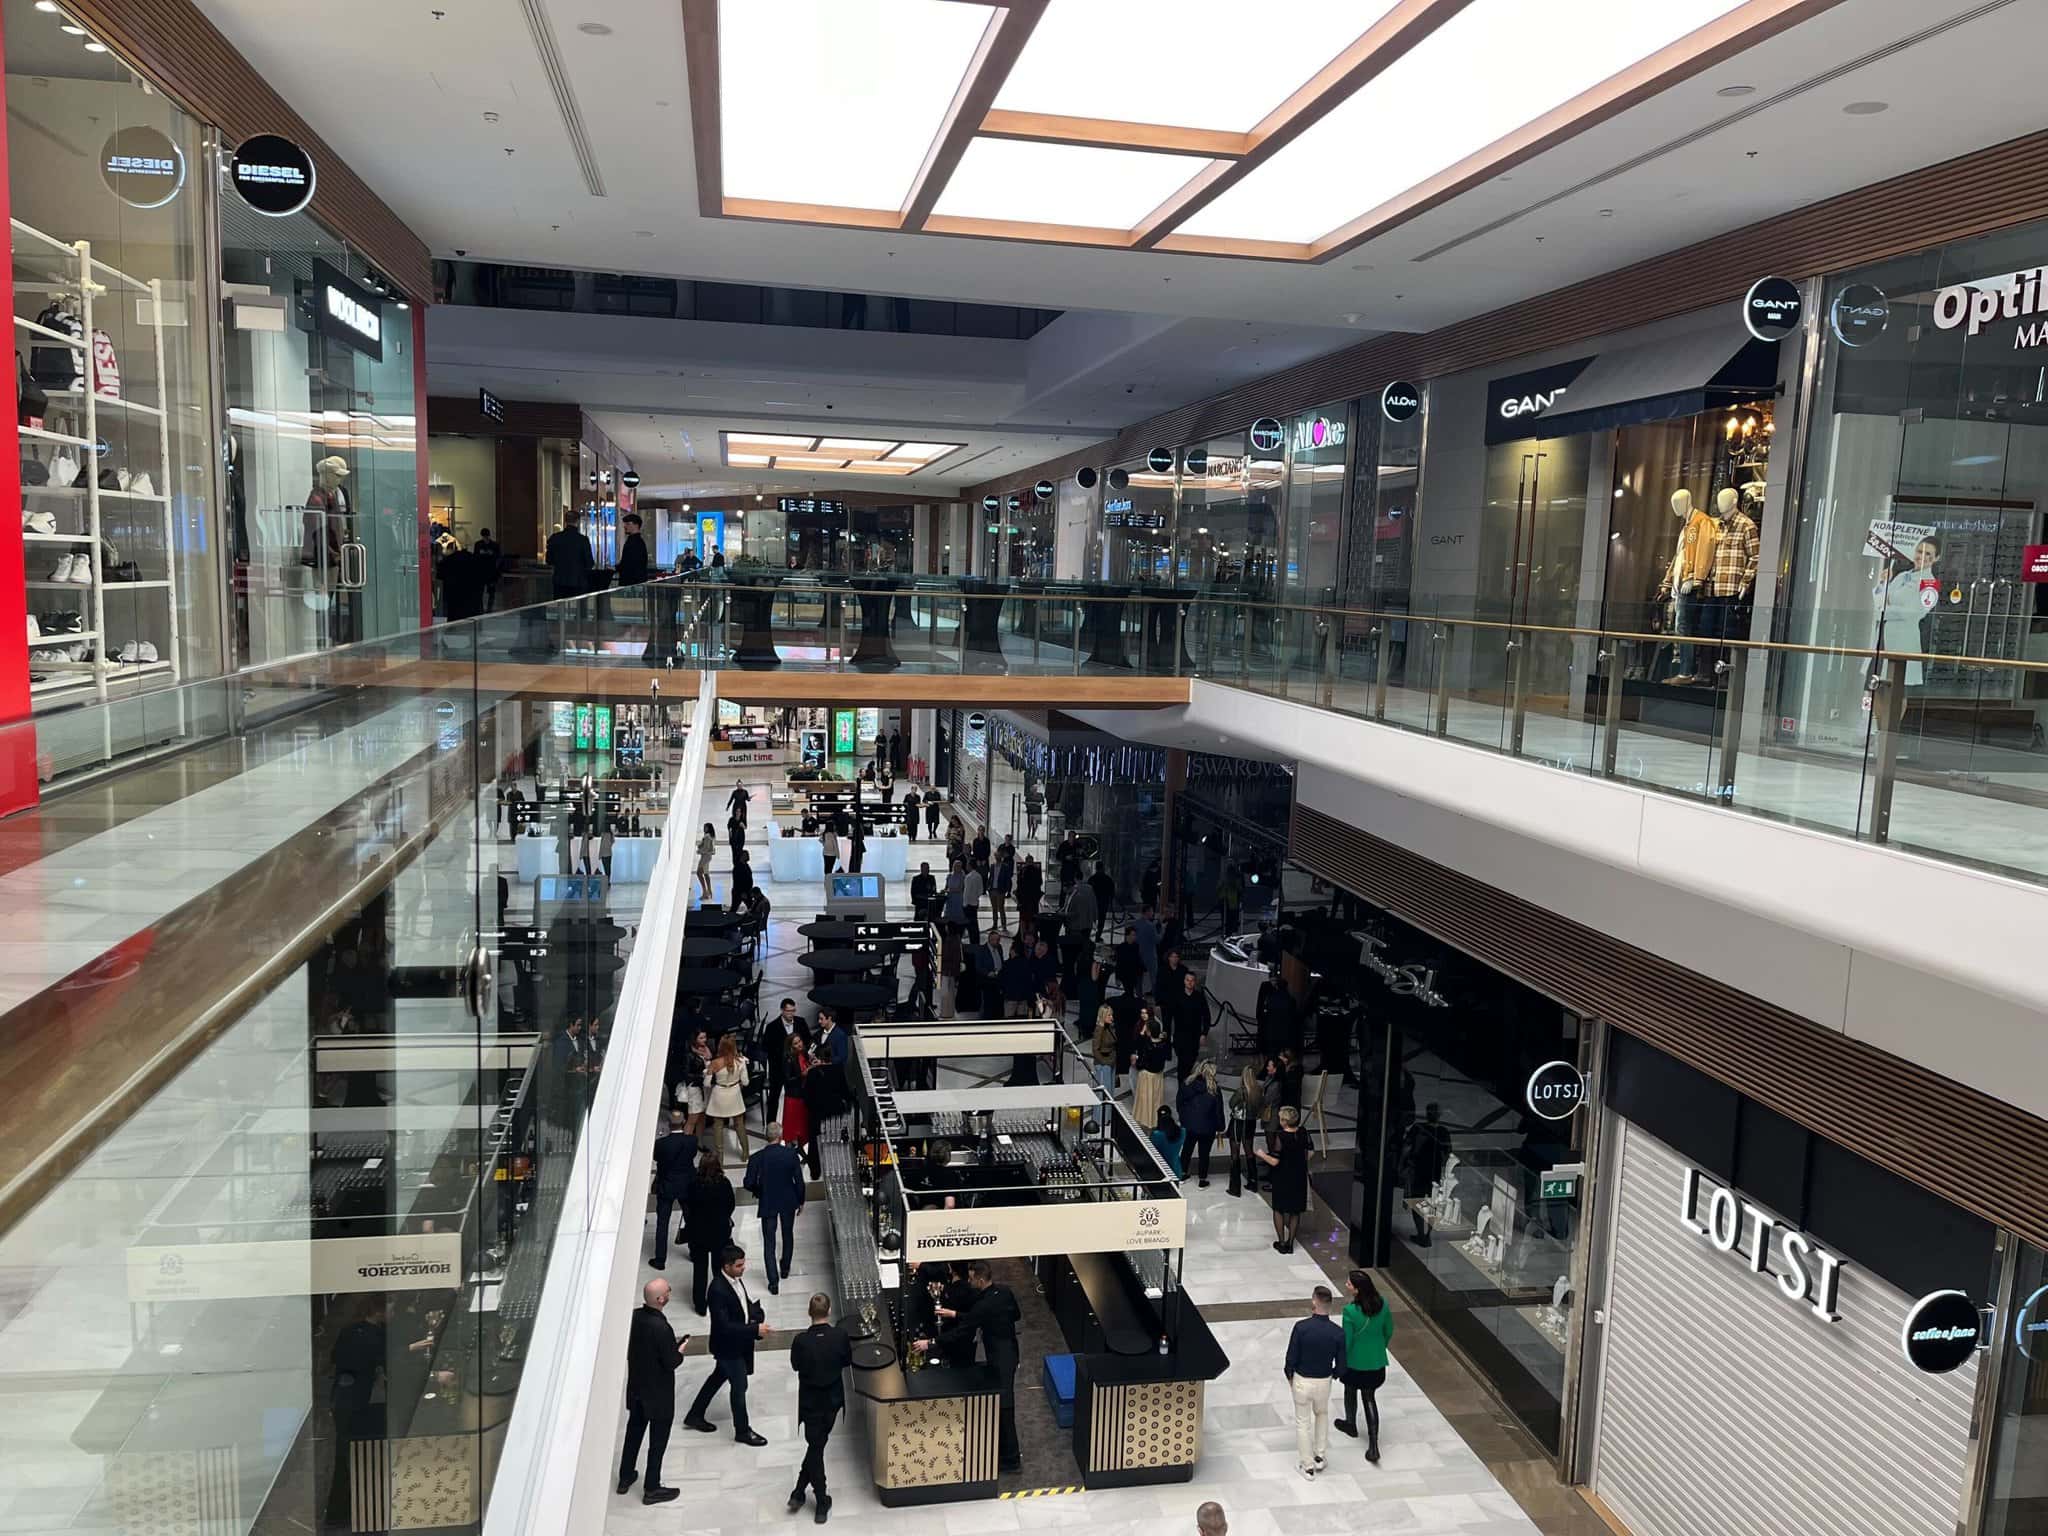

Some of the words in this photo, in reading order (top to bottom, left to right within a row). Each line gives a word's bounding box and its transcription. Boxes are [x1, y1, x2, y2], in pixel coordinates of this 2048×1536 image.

[238, 163, 304, 179] DIESEL
[1752, 298, 1799, 310] GANT
[1430, 534, 1465, 545] GANT
[728, 753, 752, 762] sushi
[753, 753, 774, 761] time
[1534, 1083, 1580, 1099] LOTSI
[917, 1236, 997, 1249] HONEYSHOP
[1681, 1166, 1840, 1324] LOTSI
